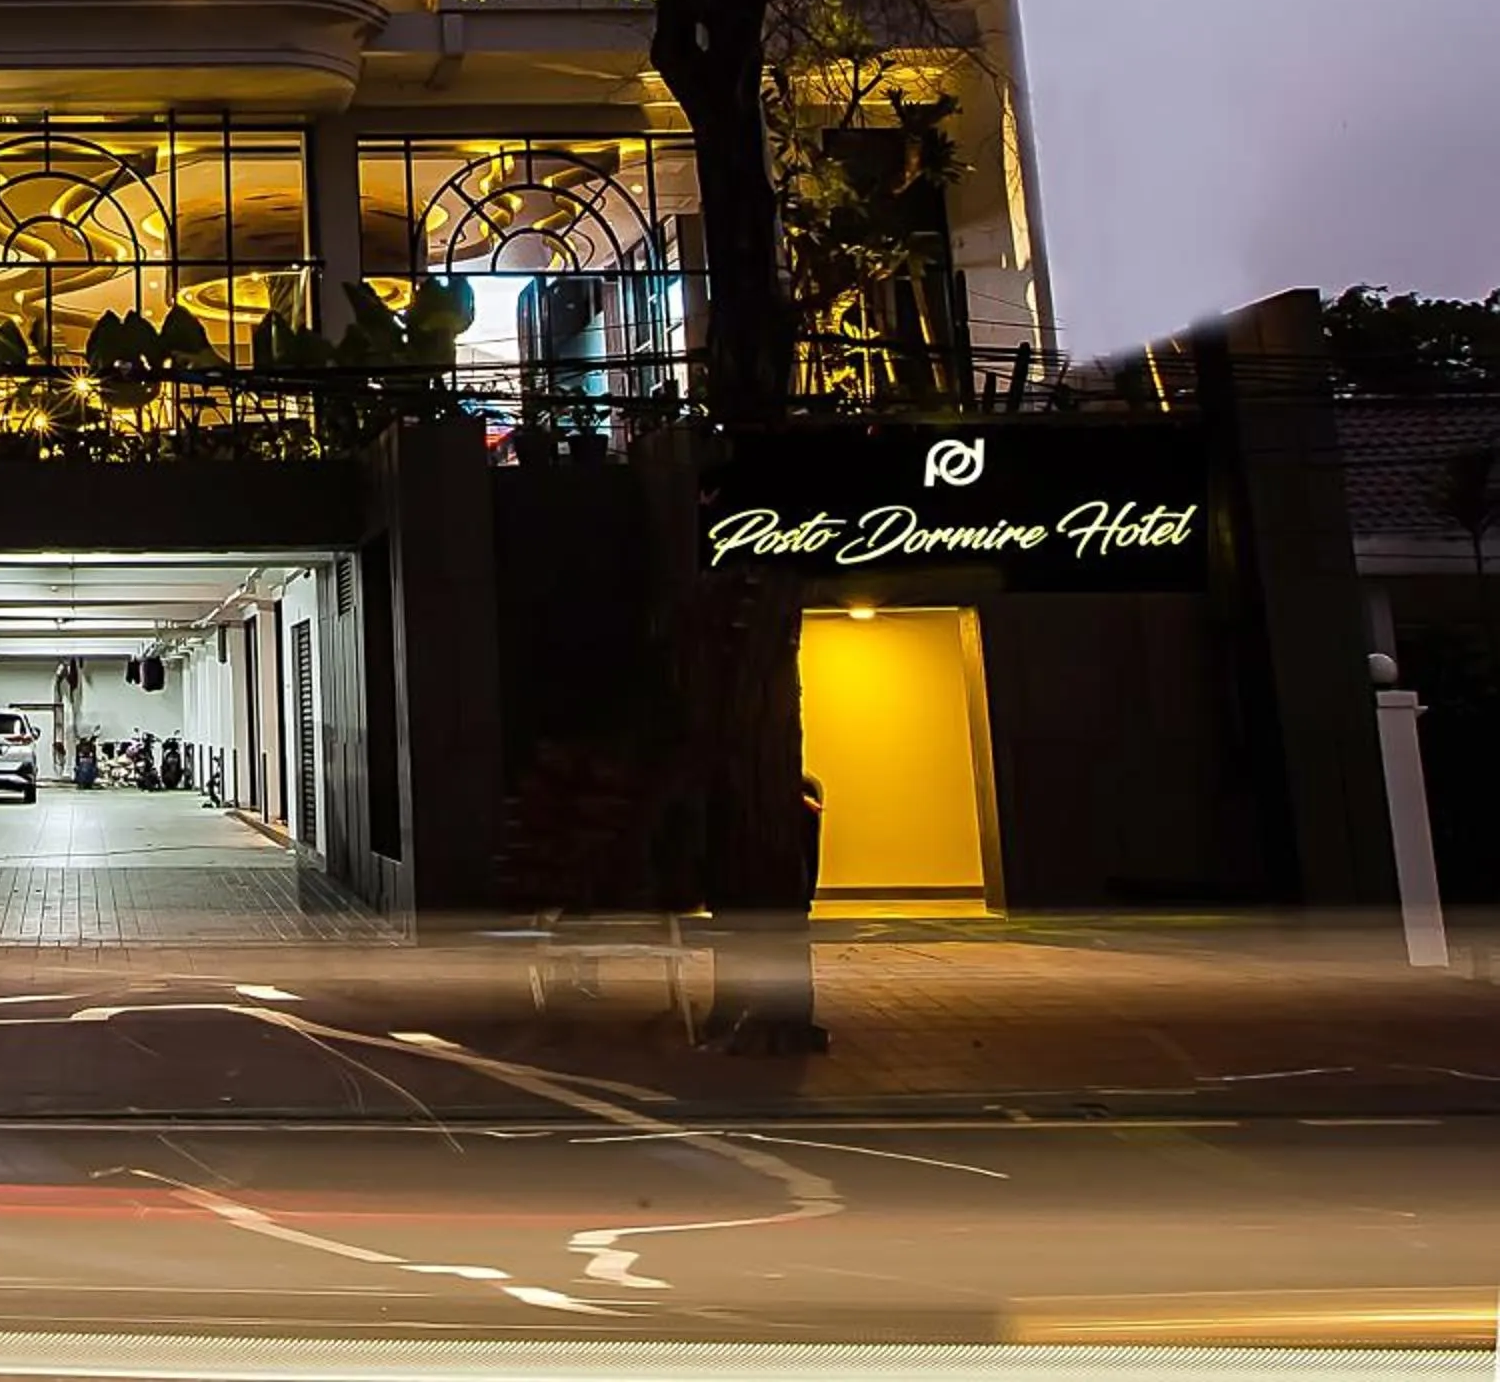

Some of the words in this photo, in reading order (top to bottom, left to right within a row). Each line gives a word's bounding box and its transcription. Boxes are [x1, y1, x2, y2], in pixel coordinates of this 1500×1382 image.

[707, 509, 848, 567] Posto
[835, 504, 1048, 565] Dormire
[1055, 500, 1198, 558] Hotel
